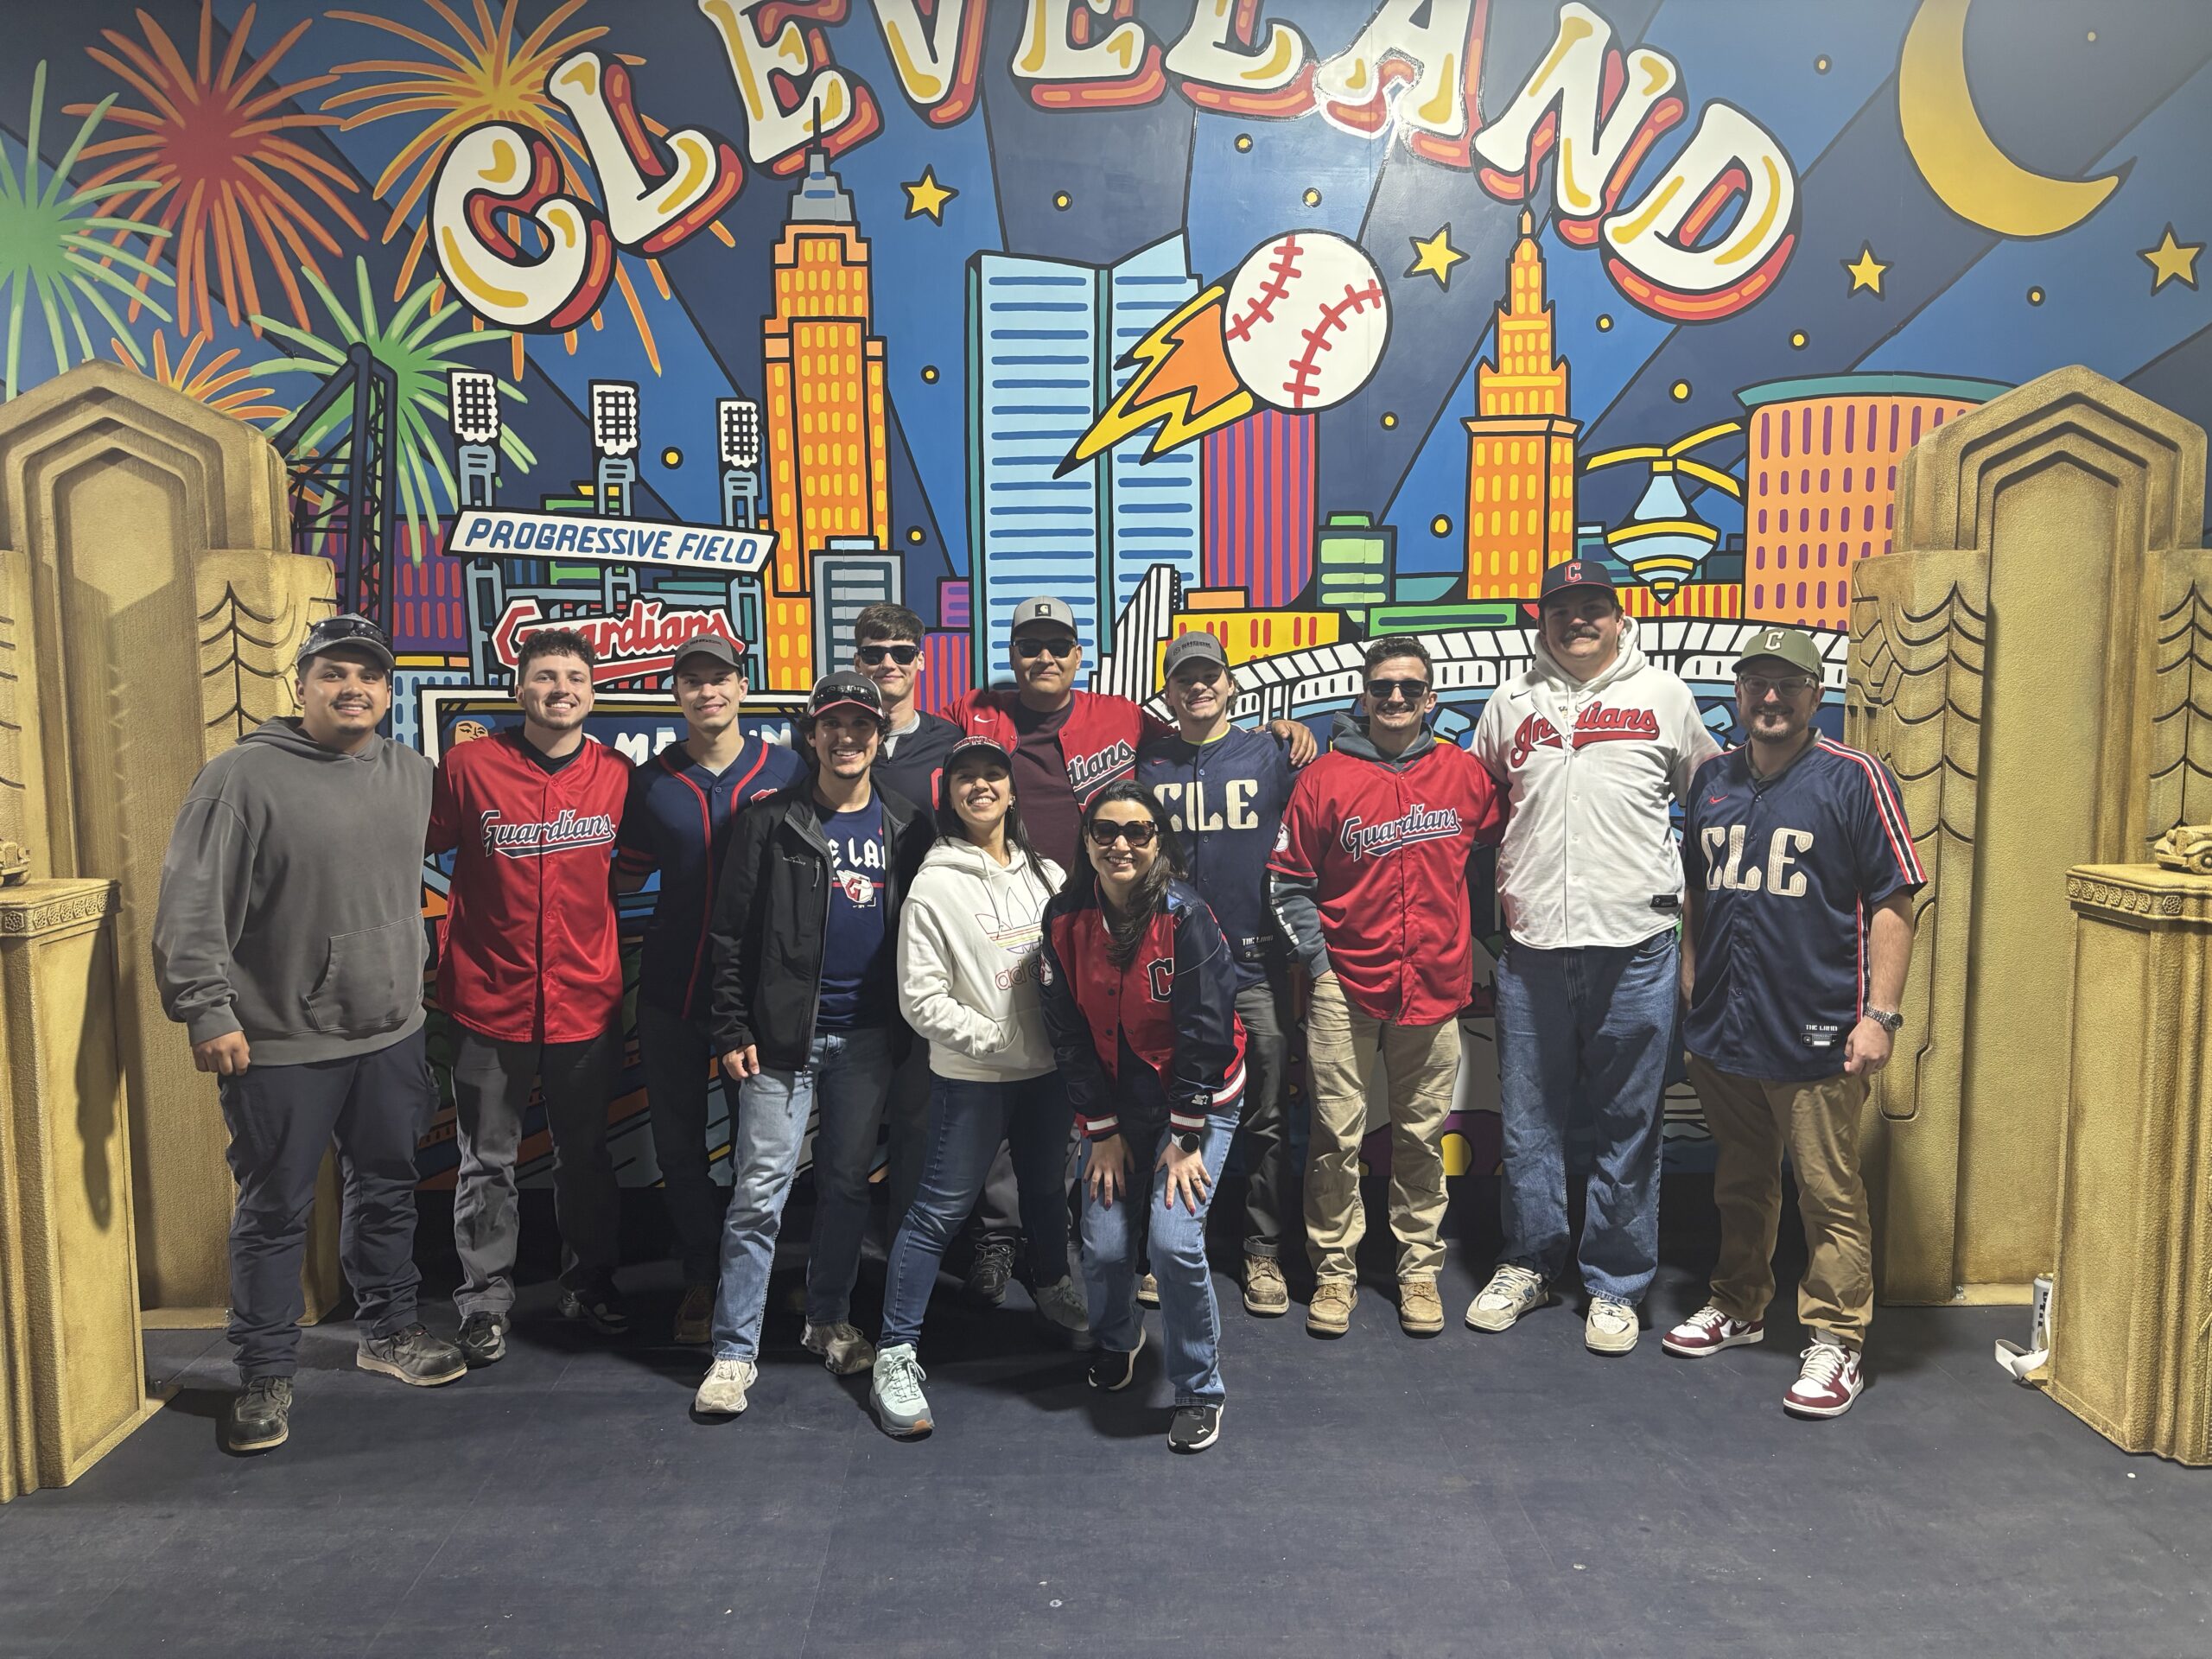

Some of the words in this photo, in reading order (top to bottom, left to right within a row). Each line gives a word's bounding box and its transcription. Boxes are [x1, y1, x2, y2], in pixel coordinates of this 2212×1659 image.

[430, 0, 1796, 330] CLEVELAND
[465, 518, 672, 560] PROGRESSIVE
[676, 532, 758, 564] FIELD
[1565, 562, 1582, 583] C
[1764, 631, 1786, 652] C
[1154, 779, 1259, 832] CLE
[480, 810, 616, 859] Guardians
[1340, 803, 1462, 862] Guardians
[1700, 824, 1814, 898] CLE
[1147, 957, 1174, 1003] C
